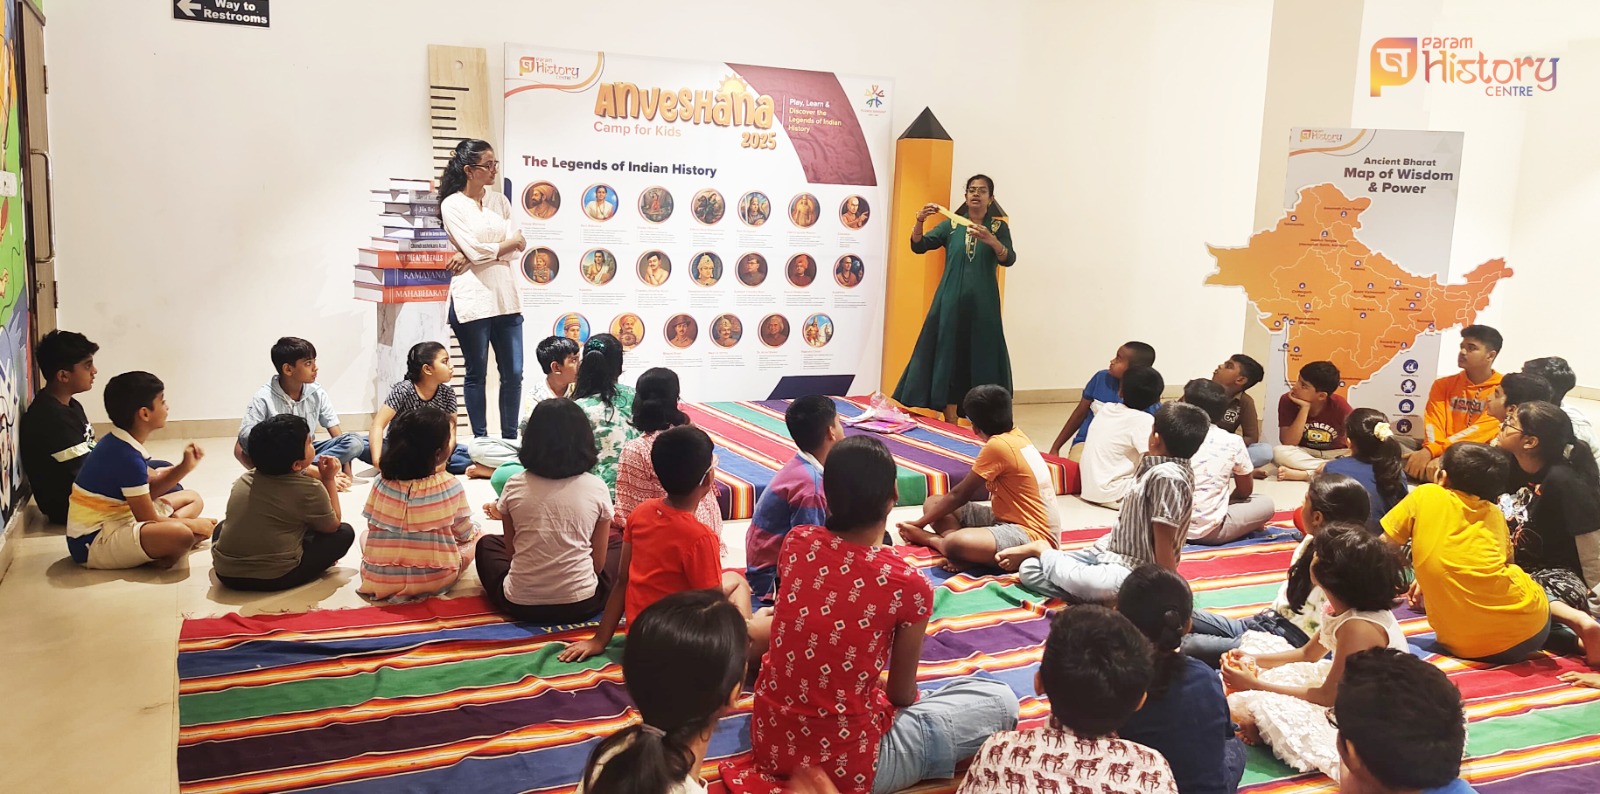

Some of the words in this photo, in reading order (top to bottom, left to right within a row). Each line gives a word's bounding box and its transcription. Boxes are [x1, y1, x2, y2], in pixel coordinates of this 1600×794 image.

[215, 0, 240, 11] Way
[244, 2, 256, 11] to
[204, 9, 268, 24] Restrooms
[536, 61, 580, 79] History
[806, 99, 824, 107] Learn
[825, 100, 830, 108] &
[789, 116, 814, 124] Legends
[594, 121, 631, 136] Camp
[634, 123, 652, 135] for
[655, 125, 682, 137] Kids
[788, 124, 810, 133] History
[741, 131, 777, 150] 2025
[522, 155, 548, 167] The
[552, 157, 608, 171] Legends
[611, 161, 625, 172] of
[628, 161, 668, 174] Indian
[672, 164, 717, 178] History
[1364, 157, 1401, 166] Ancient
[1403, 158, 1436, 166] Bharat
[1344, 167, 1375, 181] Map
[1379, 168, 1394, 179] of
[1397, 168, 1454, 181] Wisdom
[1368, 181, 1378, 192] &
[1382, 182, 1427, 194] Power
[403, 271, 447, 280] RAMAYANA
